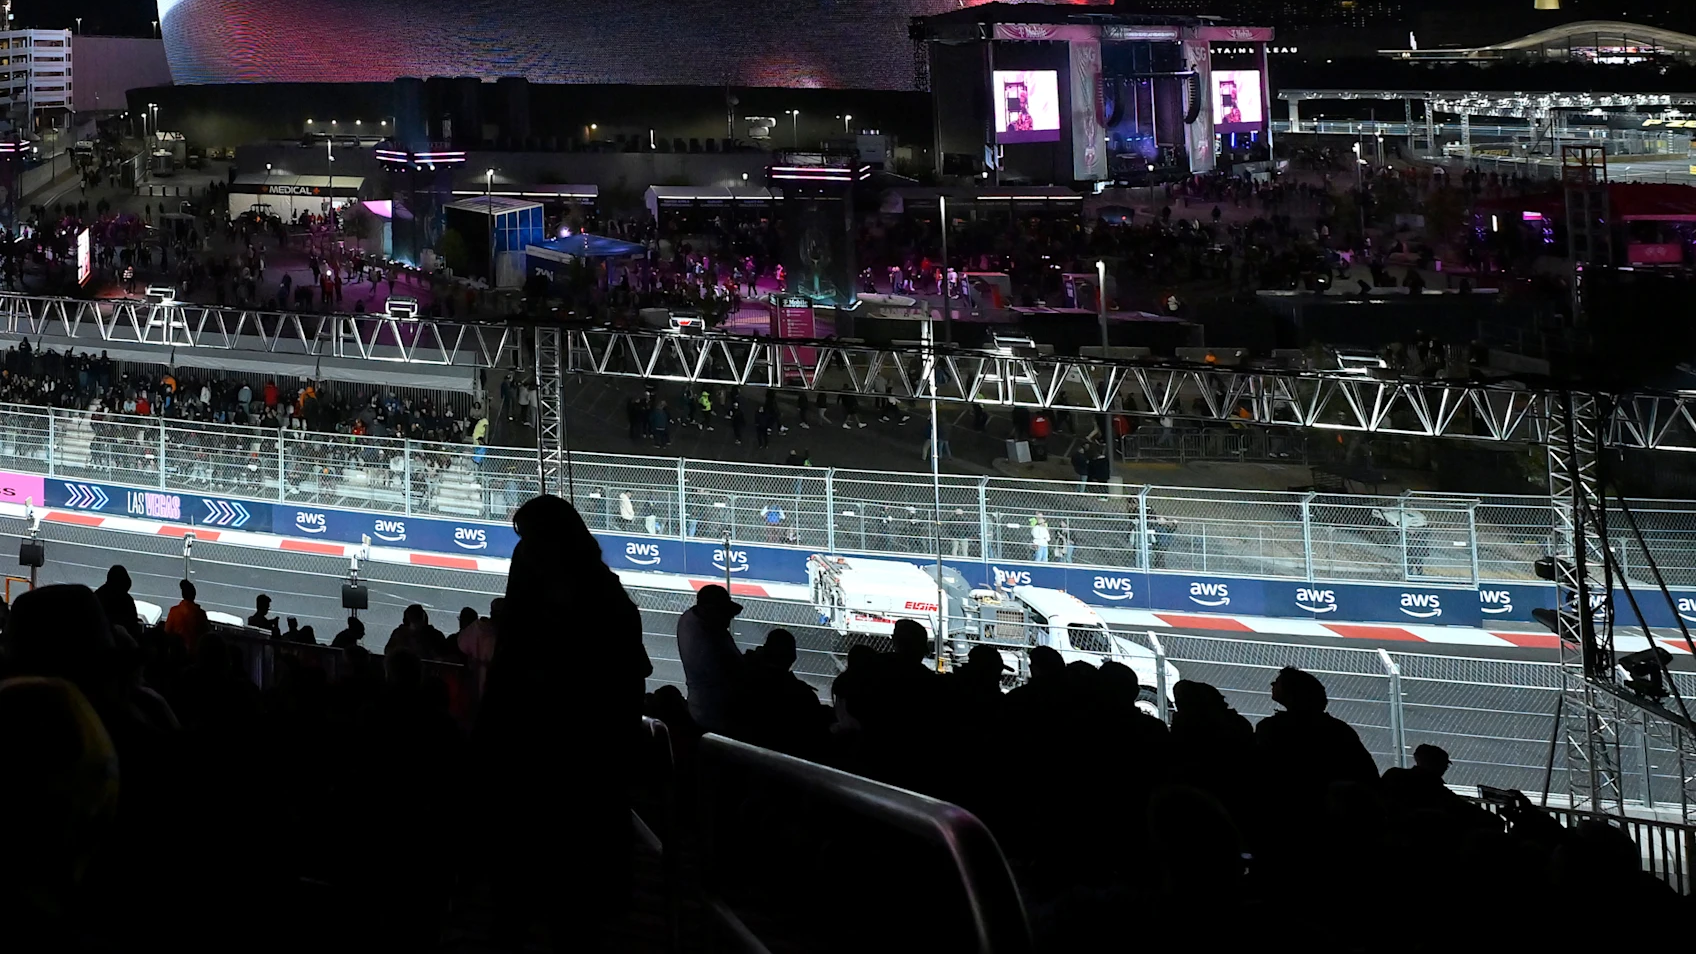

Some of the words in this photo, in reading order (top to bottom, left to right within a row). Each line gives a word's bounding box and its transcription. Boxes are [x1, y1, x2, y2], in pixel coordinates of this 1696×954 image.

[269, 185, 312, 195] MEDICAL
[127, 491, 145, 515] LAS
[145, 492, 181, 520] VEGAS
[296, 511, 326, 526] aws
[375, 519, 405, 534] aws
[454, 528, 486, 542] aws
[626, 542, 659, 557] aws
[713, 548, 748, 564] aws
[1093, 576, 1132, 591] aws
[1190, 582, 1229, 597] aws
[1296, 588, 1335, 604] aws
[1400, 593, 1440, 608] aws
